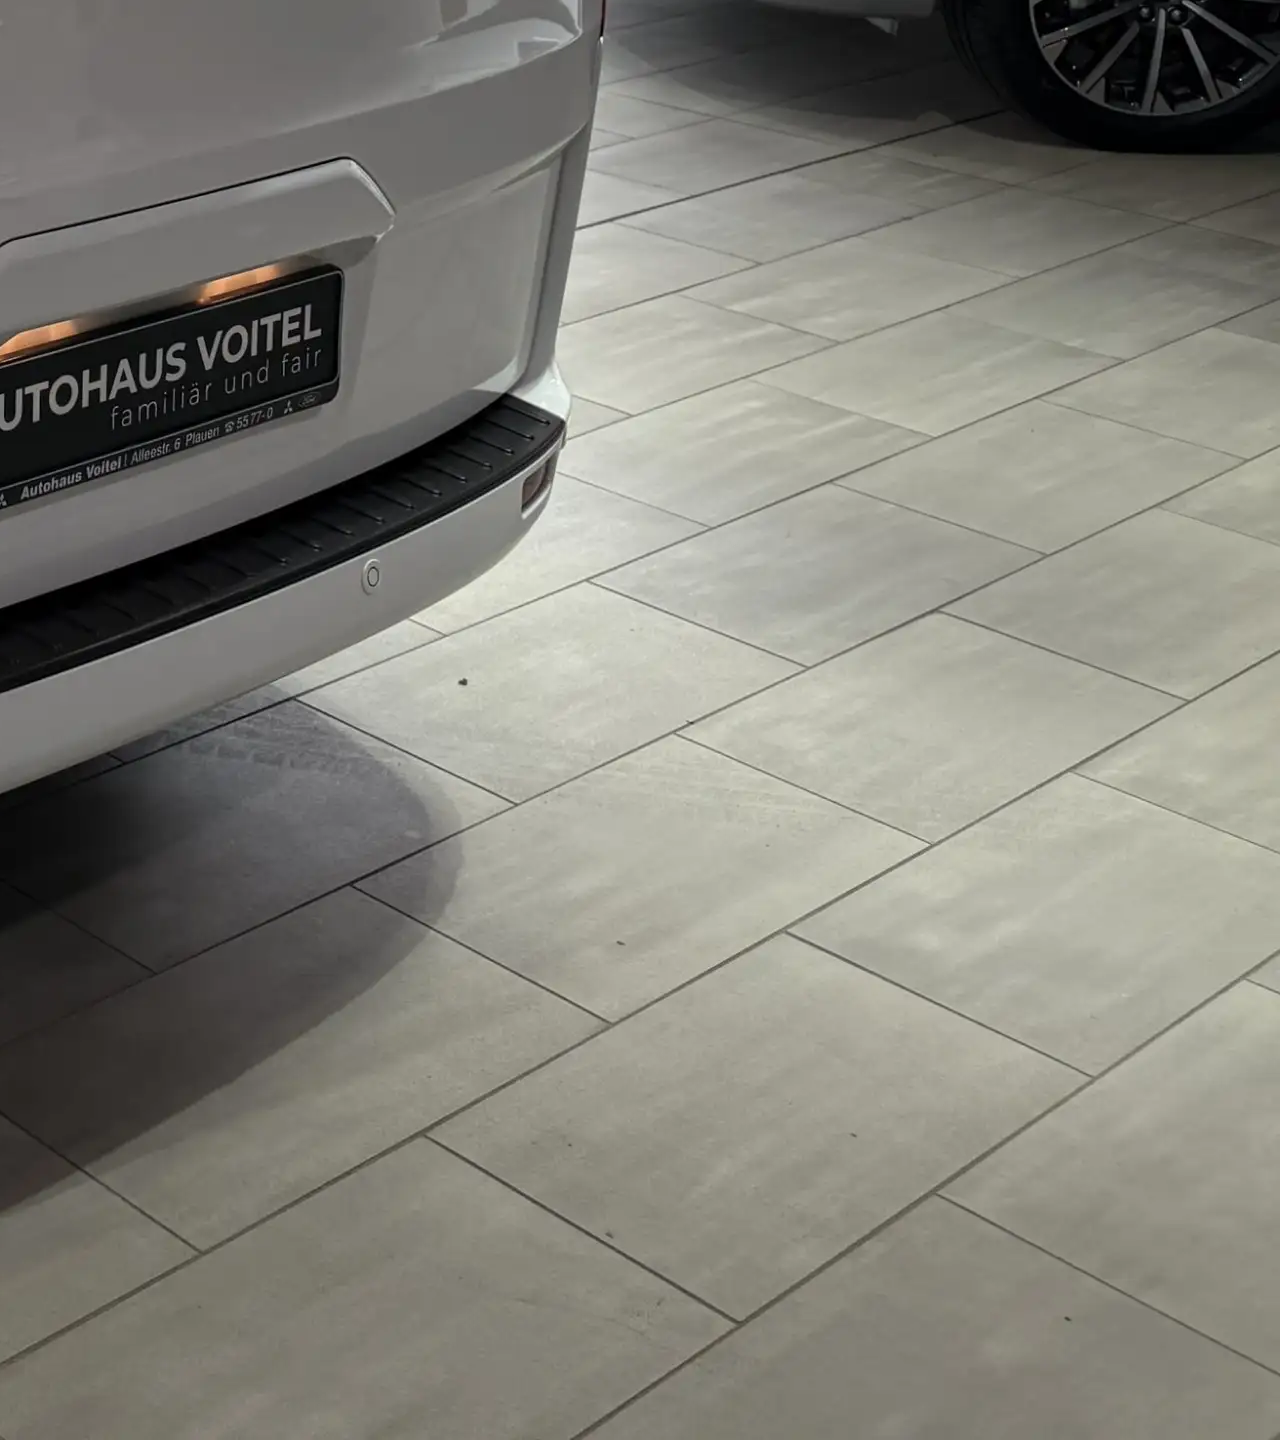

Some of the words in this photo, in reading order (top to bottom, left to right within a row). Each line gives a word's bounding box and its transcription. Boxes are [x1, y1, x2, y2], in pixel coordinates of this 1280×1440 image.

[196, 303, 323, 369] VOITEL
[111, 381, 212, 432] familiär
[224, 359, 270, 395] und
[281, 346, 322, 377] fair
[21, 471, 82, 500] Autohaus
[86, 456, 122, 479] Voitel
[130, 441, 171, 466] Alleestr.
[174, 436, 181, 451] 6
[185, 427, 220, 447] Plauen
